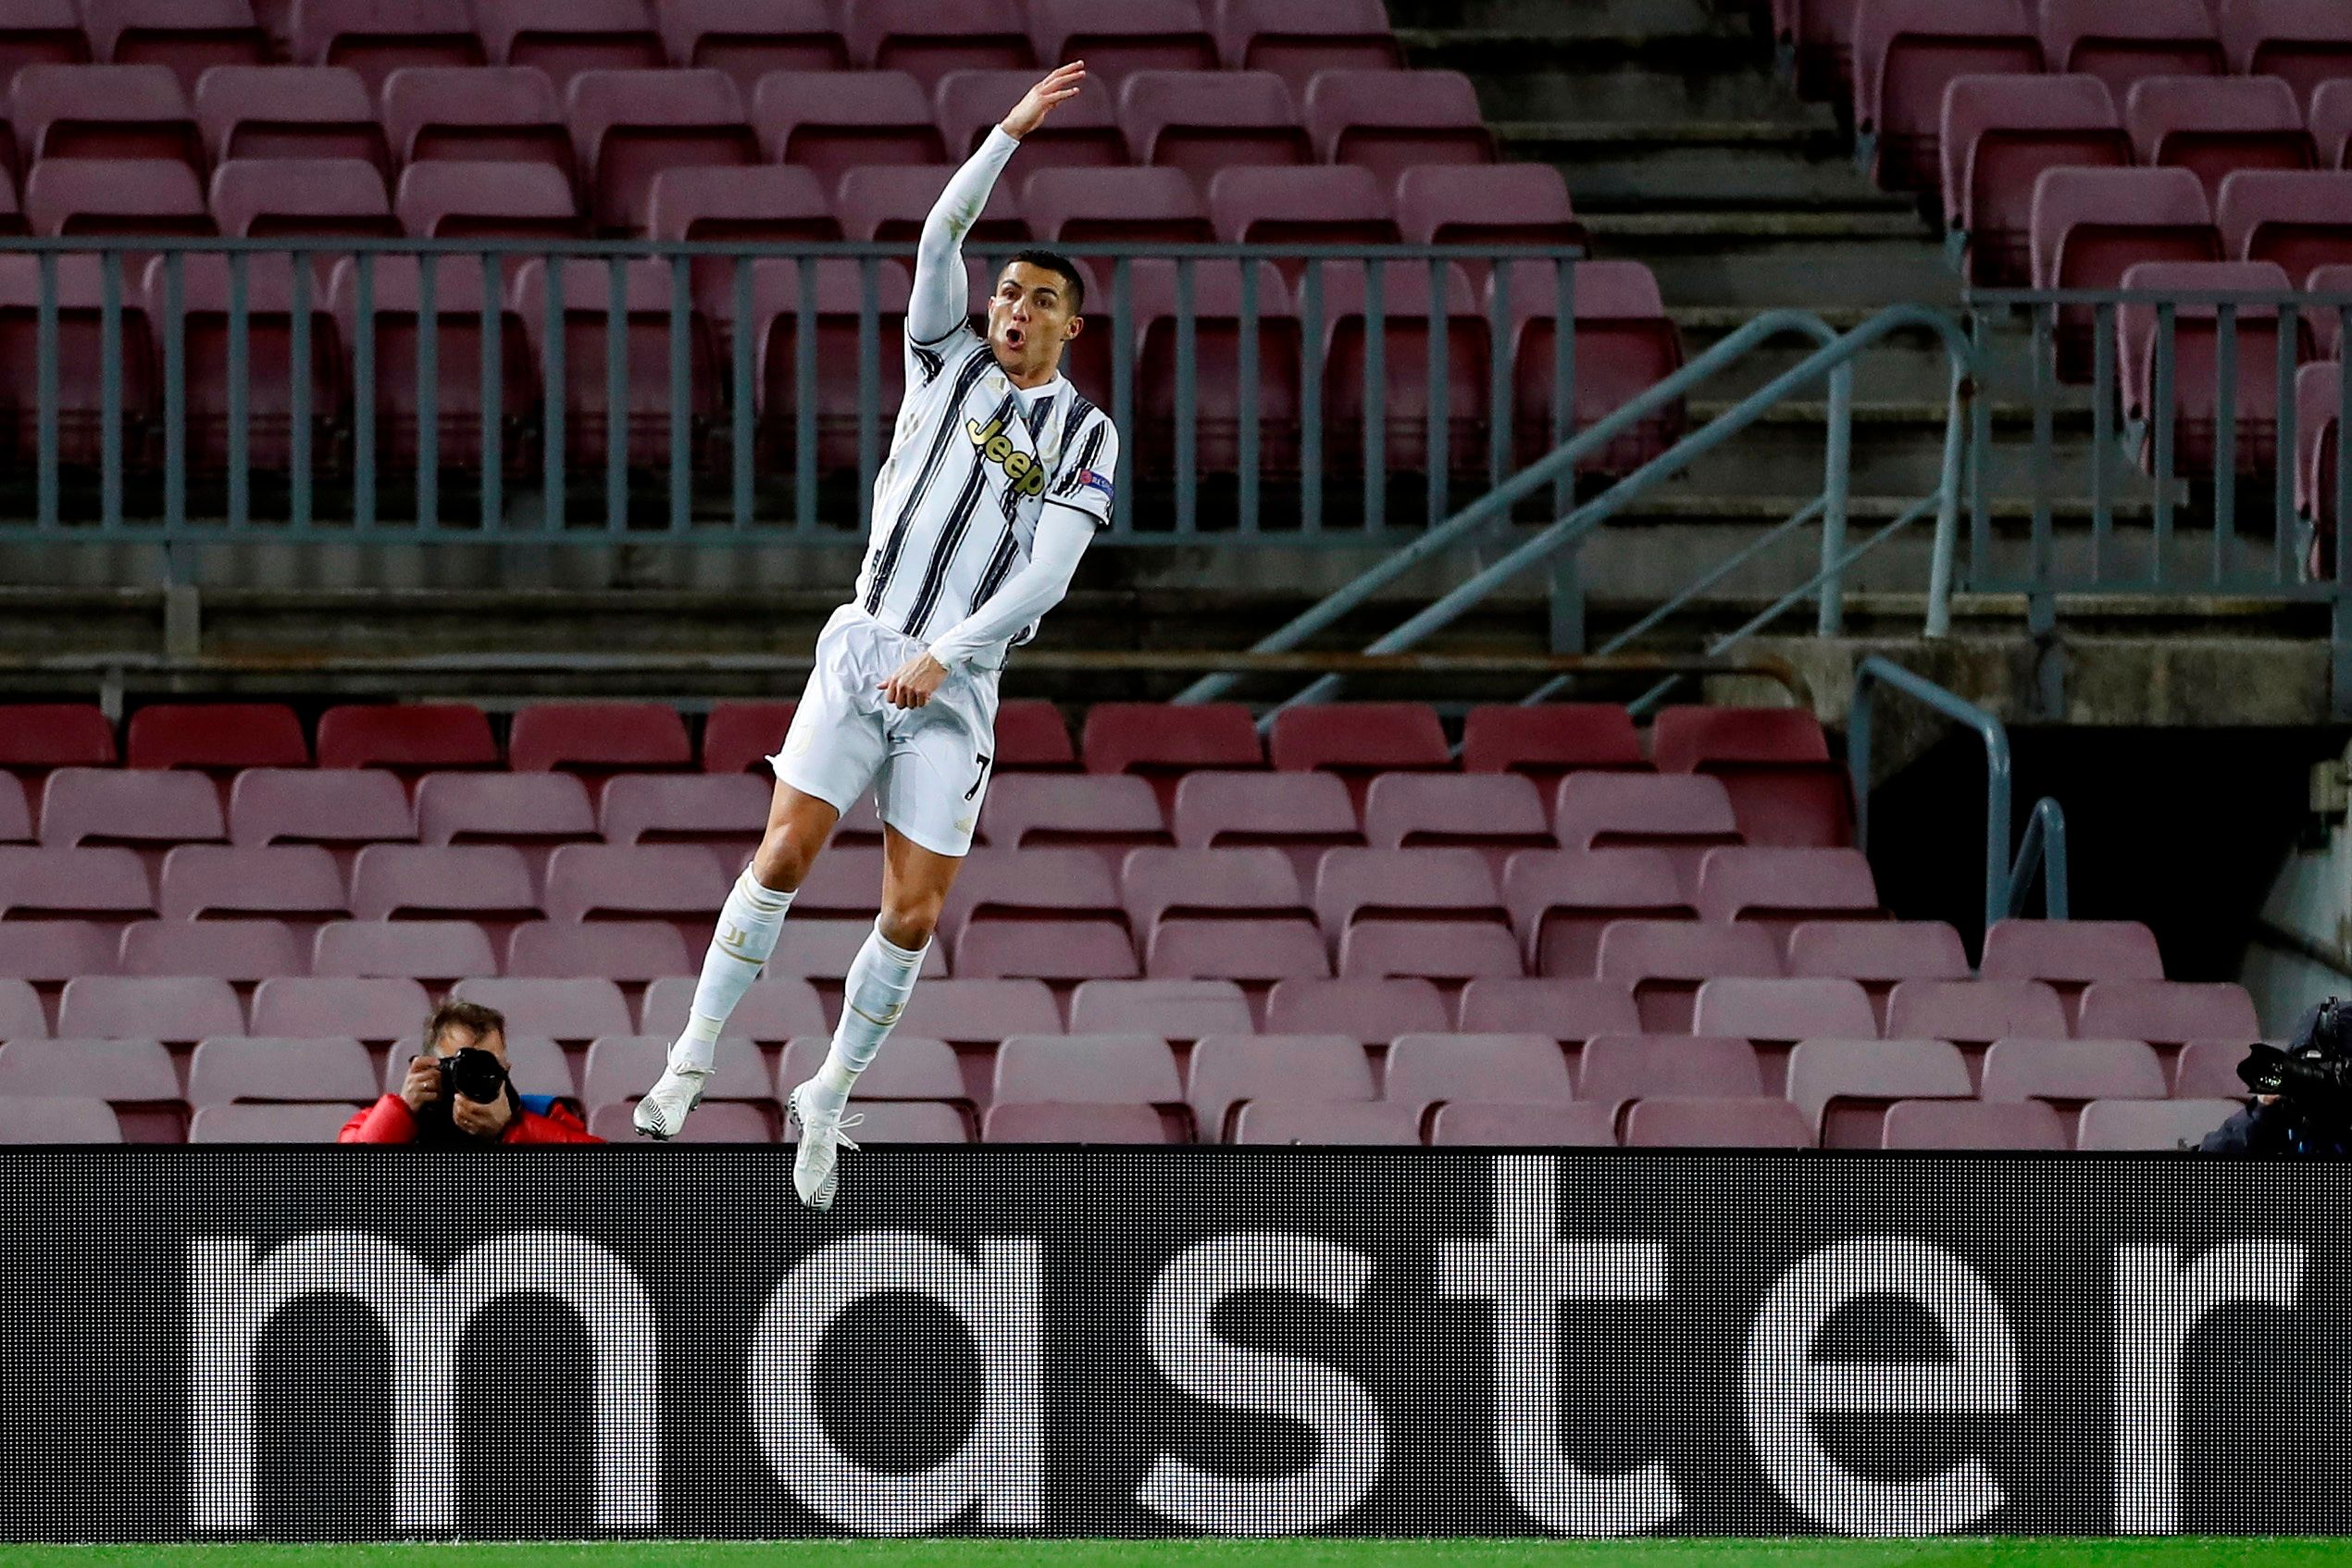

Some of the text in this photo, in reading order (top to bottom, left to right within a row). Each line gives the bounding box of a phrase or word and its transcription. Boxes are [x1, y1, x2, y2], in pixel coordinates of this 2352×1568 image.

[966, 417, 1045, 497] Jeep
[964, 753, 990, 801] 7
[188, 1155, 2308, 1538] master
